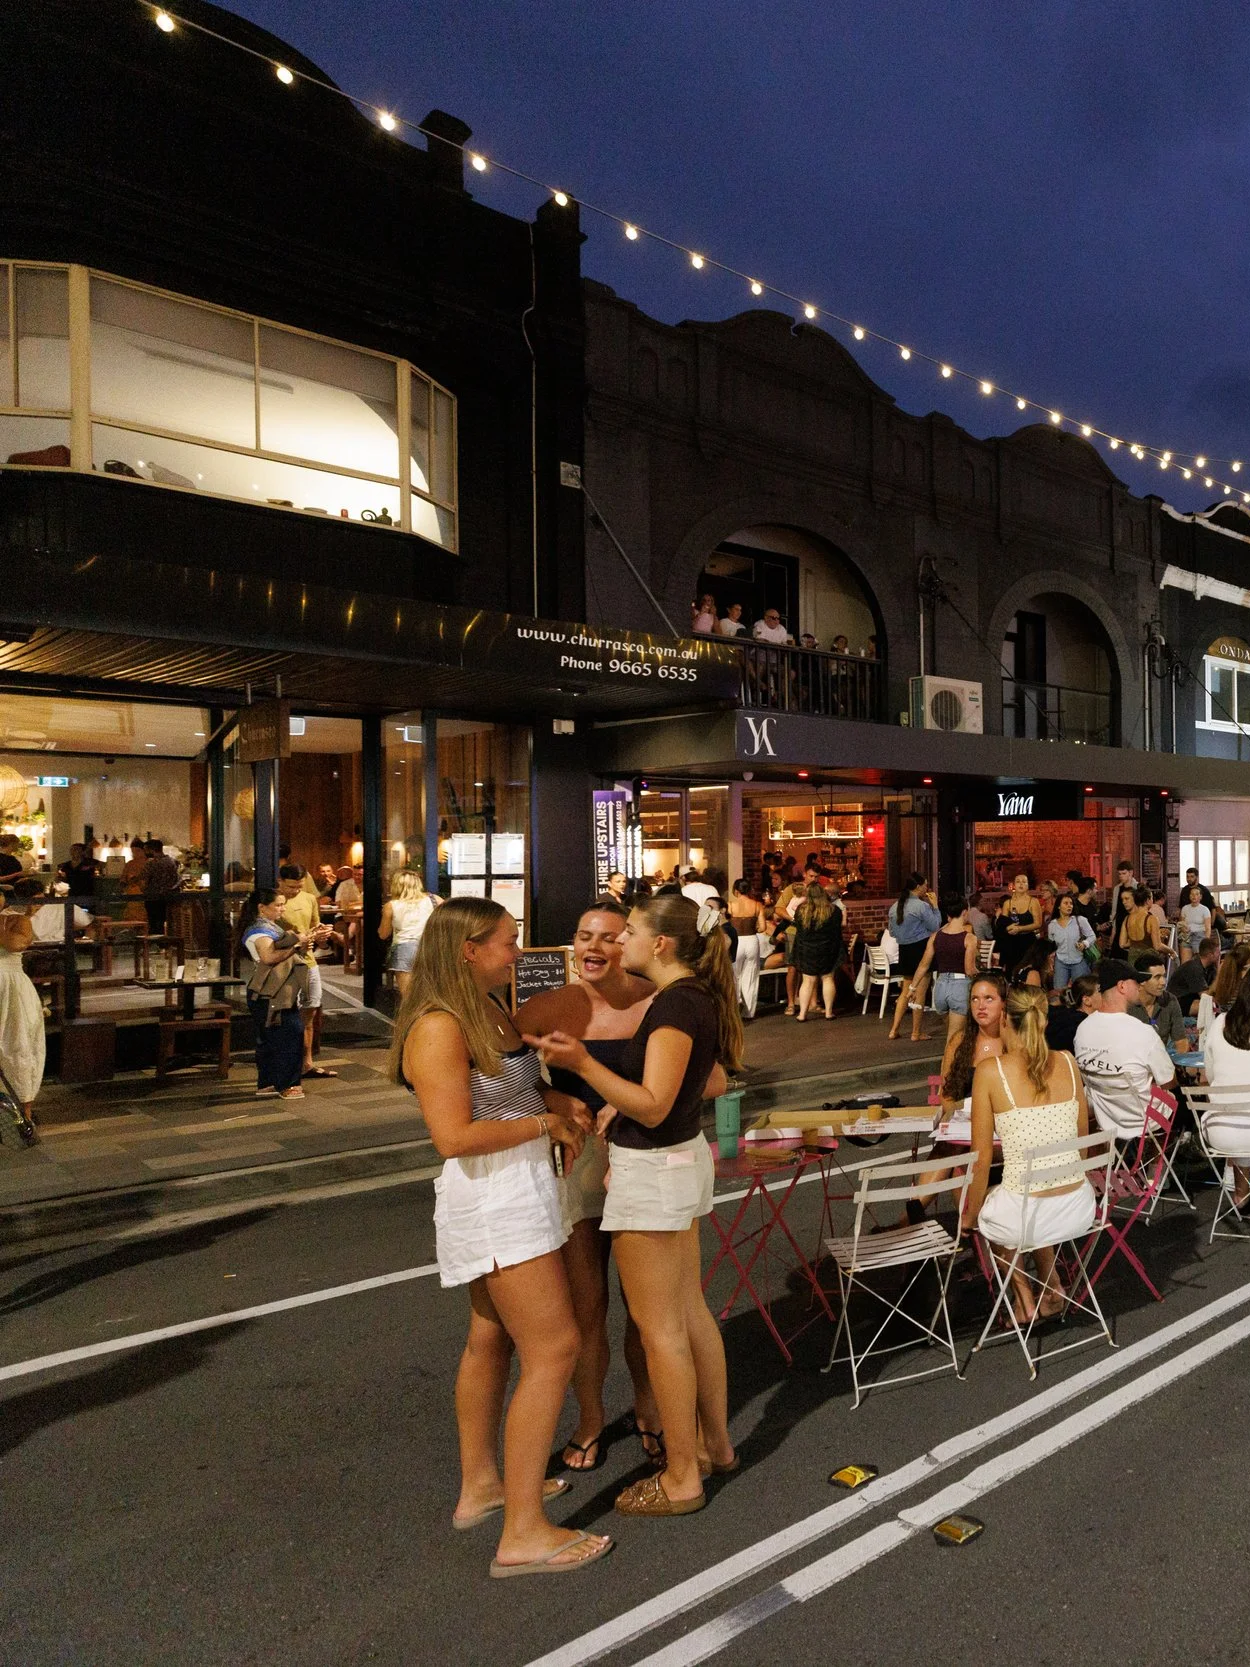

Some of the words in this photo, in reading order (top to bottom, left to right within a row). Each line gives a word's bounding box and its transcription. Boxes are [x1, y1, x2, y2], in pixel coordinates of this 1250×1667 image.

[1220, 644, 1250, 660] ONDA
[561, 655, 602, 671] Phone
[609, 659, 652, 677] 9665
[658, 665, 698, 682] 6535
[997, 792, 1034, 816] Yana
[596, 801, 608, 858] UPSTAIRS
[598, 860, 609, 888] HIRE
[517, 954, 561, 965] Specials
[517, 969, 531, 978] Hot
[516, 980, 542, 989] Jacket
